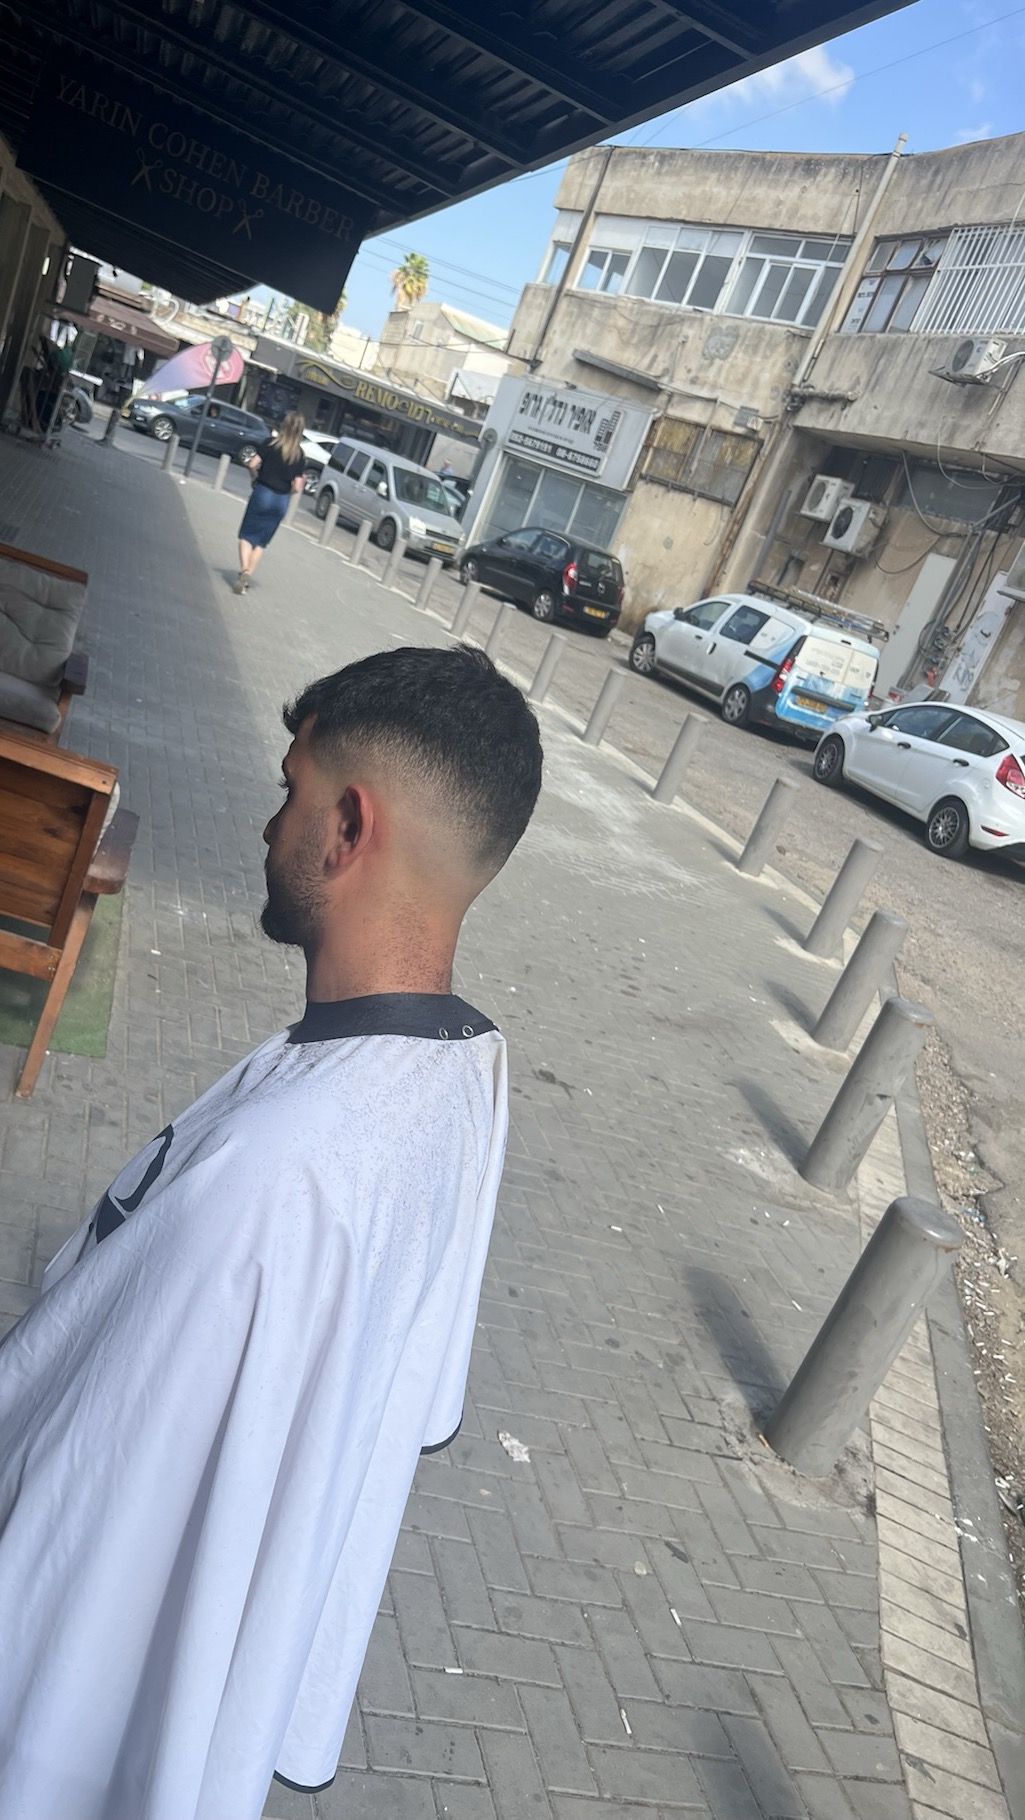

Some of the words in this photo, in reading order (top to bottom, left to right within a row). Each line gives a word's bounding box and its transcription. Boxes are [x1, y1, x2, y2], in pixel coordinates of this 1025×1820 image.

[56, 74, 143, 136] YARIN
[148, 122, 249, 187] COHEN
[250, 171, 356, 243] BARBER
[159, 168, 234, 219] SHOP
